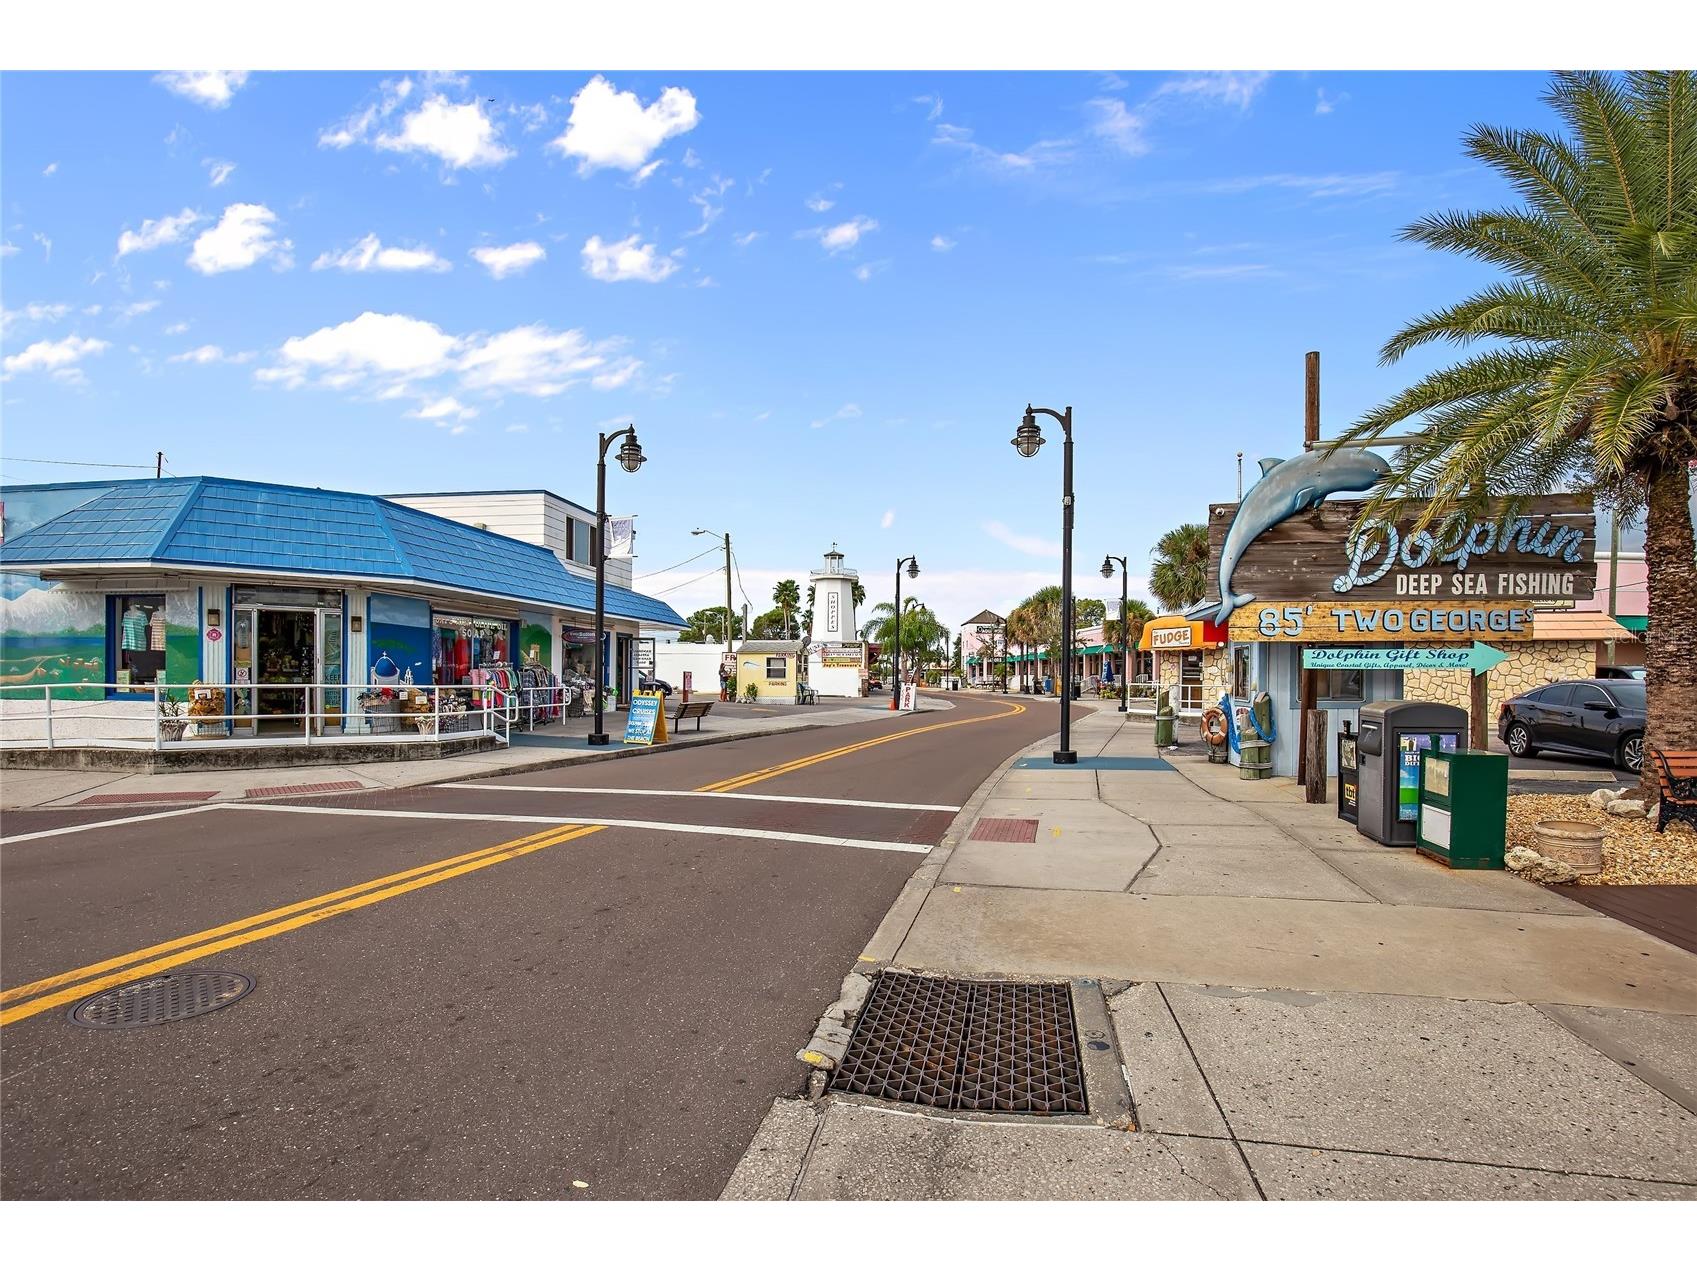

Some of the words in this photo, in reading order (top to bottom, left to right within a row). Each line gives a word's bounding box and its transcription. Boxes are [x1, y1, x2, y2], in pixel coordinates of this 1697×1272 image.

[1332, 517, 1584, 594] Dolphin
[1396, 573, 1442, 596] DEEP
[1451, 573, 1488, 596] SEA
[1498, 573, 1574, 596] FISHING
[1331, 609, 1404, 635] TWO
[462, 628, 486, 639] SOAP
[1153, 629, 1190, 646] FUDGE
[1312, 650, 1381, 662] Dolphin
[1385, 650, 1420, 662] Gift
[1425, 650, 1470, 662] Shop
[903, 686, 912, 708] PARK
